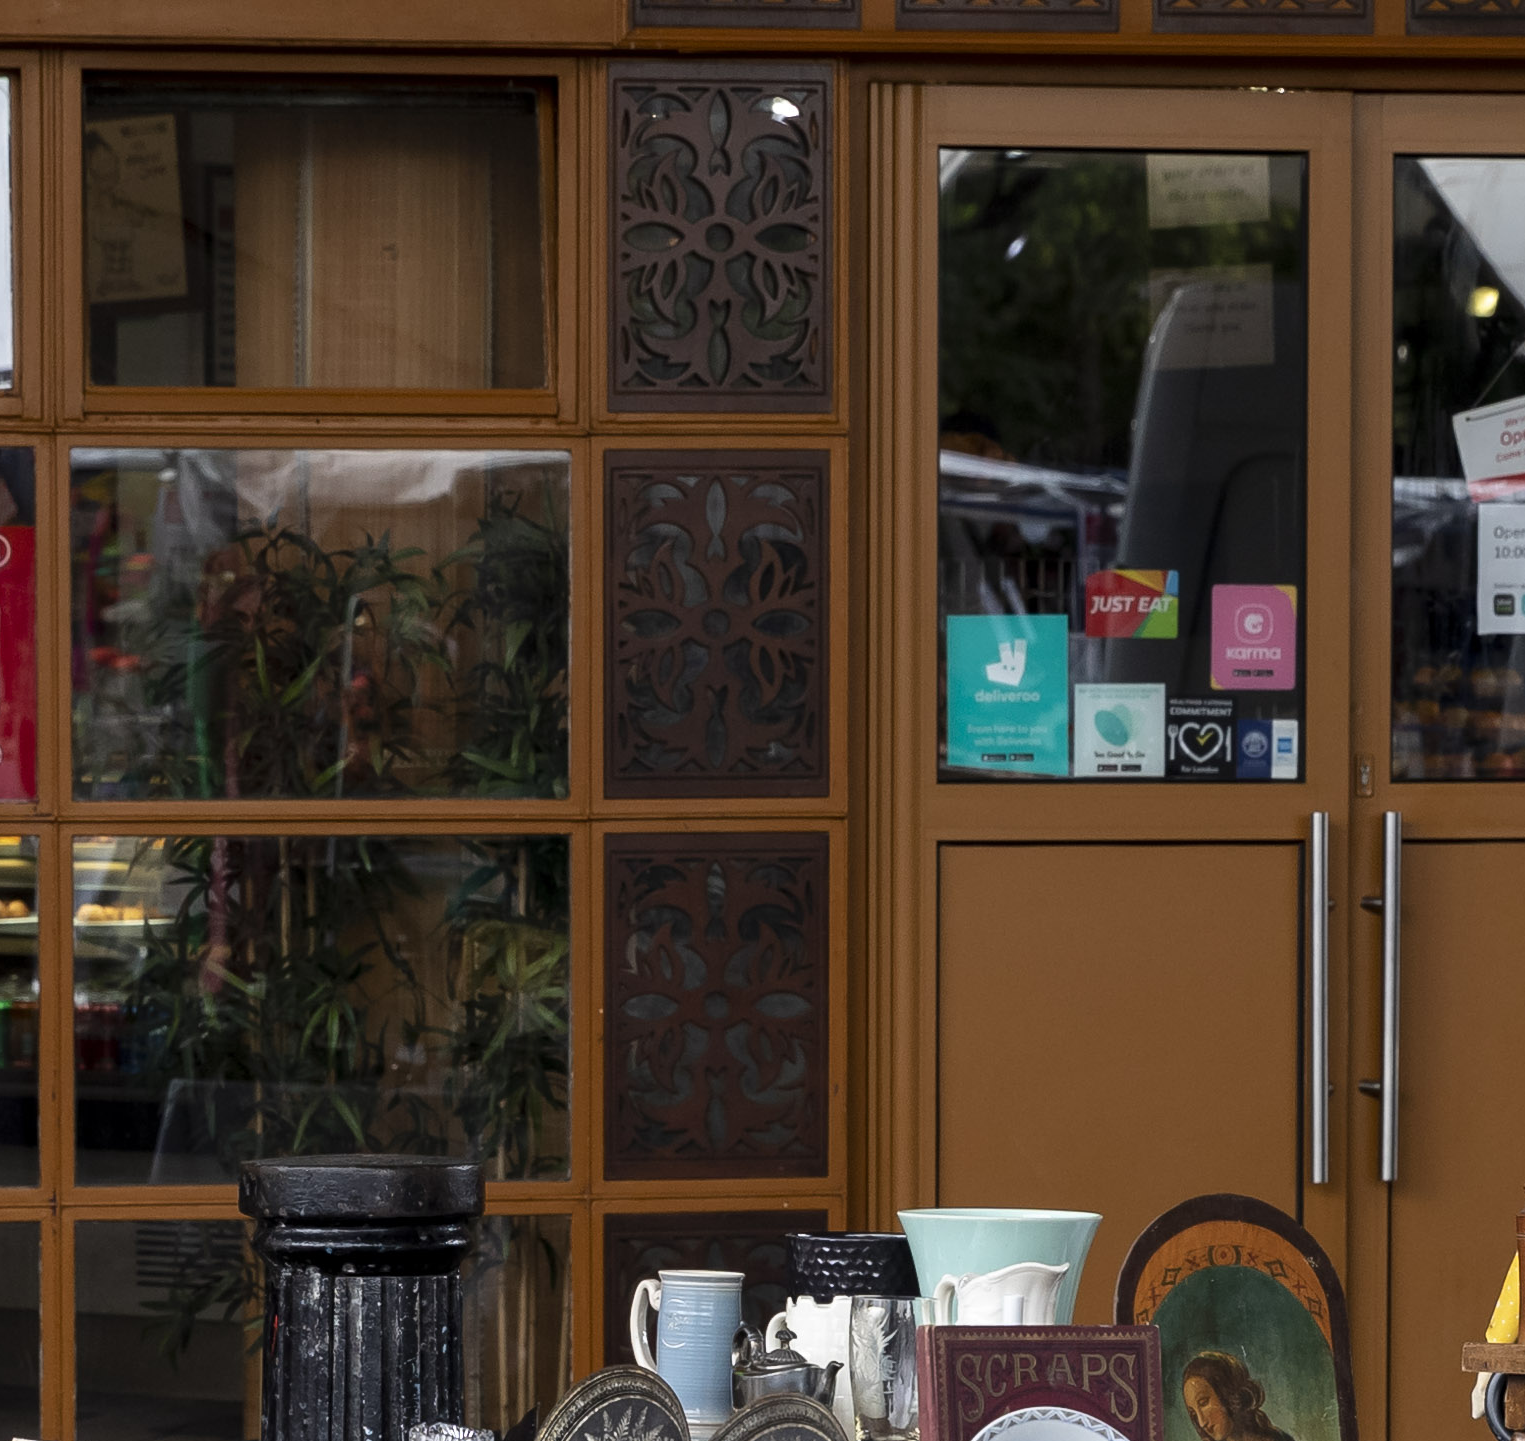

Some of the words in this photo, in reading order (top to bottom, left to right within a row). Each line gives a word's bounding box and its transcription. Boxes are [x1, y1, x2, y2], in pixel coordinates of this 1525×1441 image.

[1090, 596, 1134, 613] JUST
[1138, 597, 1172, 612] EAT
[975, 689, 1040, 702] deliveroo
[1169, 707, 1232, 716] COMMITMENT
[956, 1353, 1138, 1423] SCRAPS
